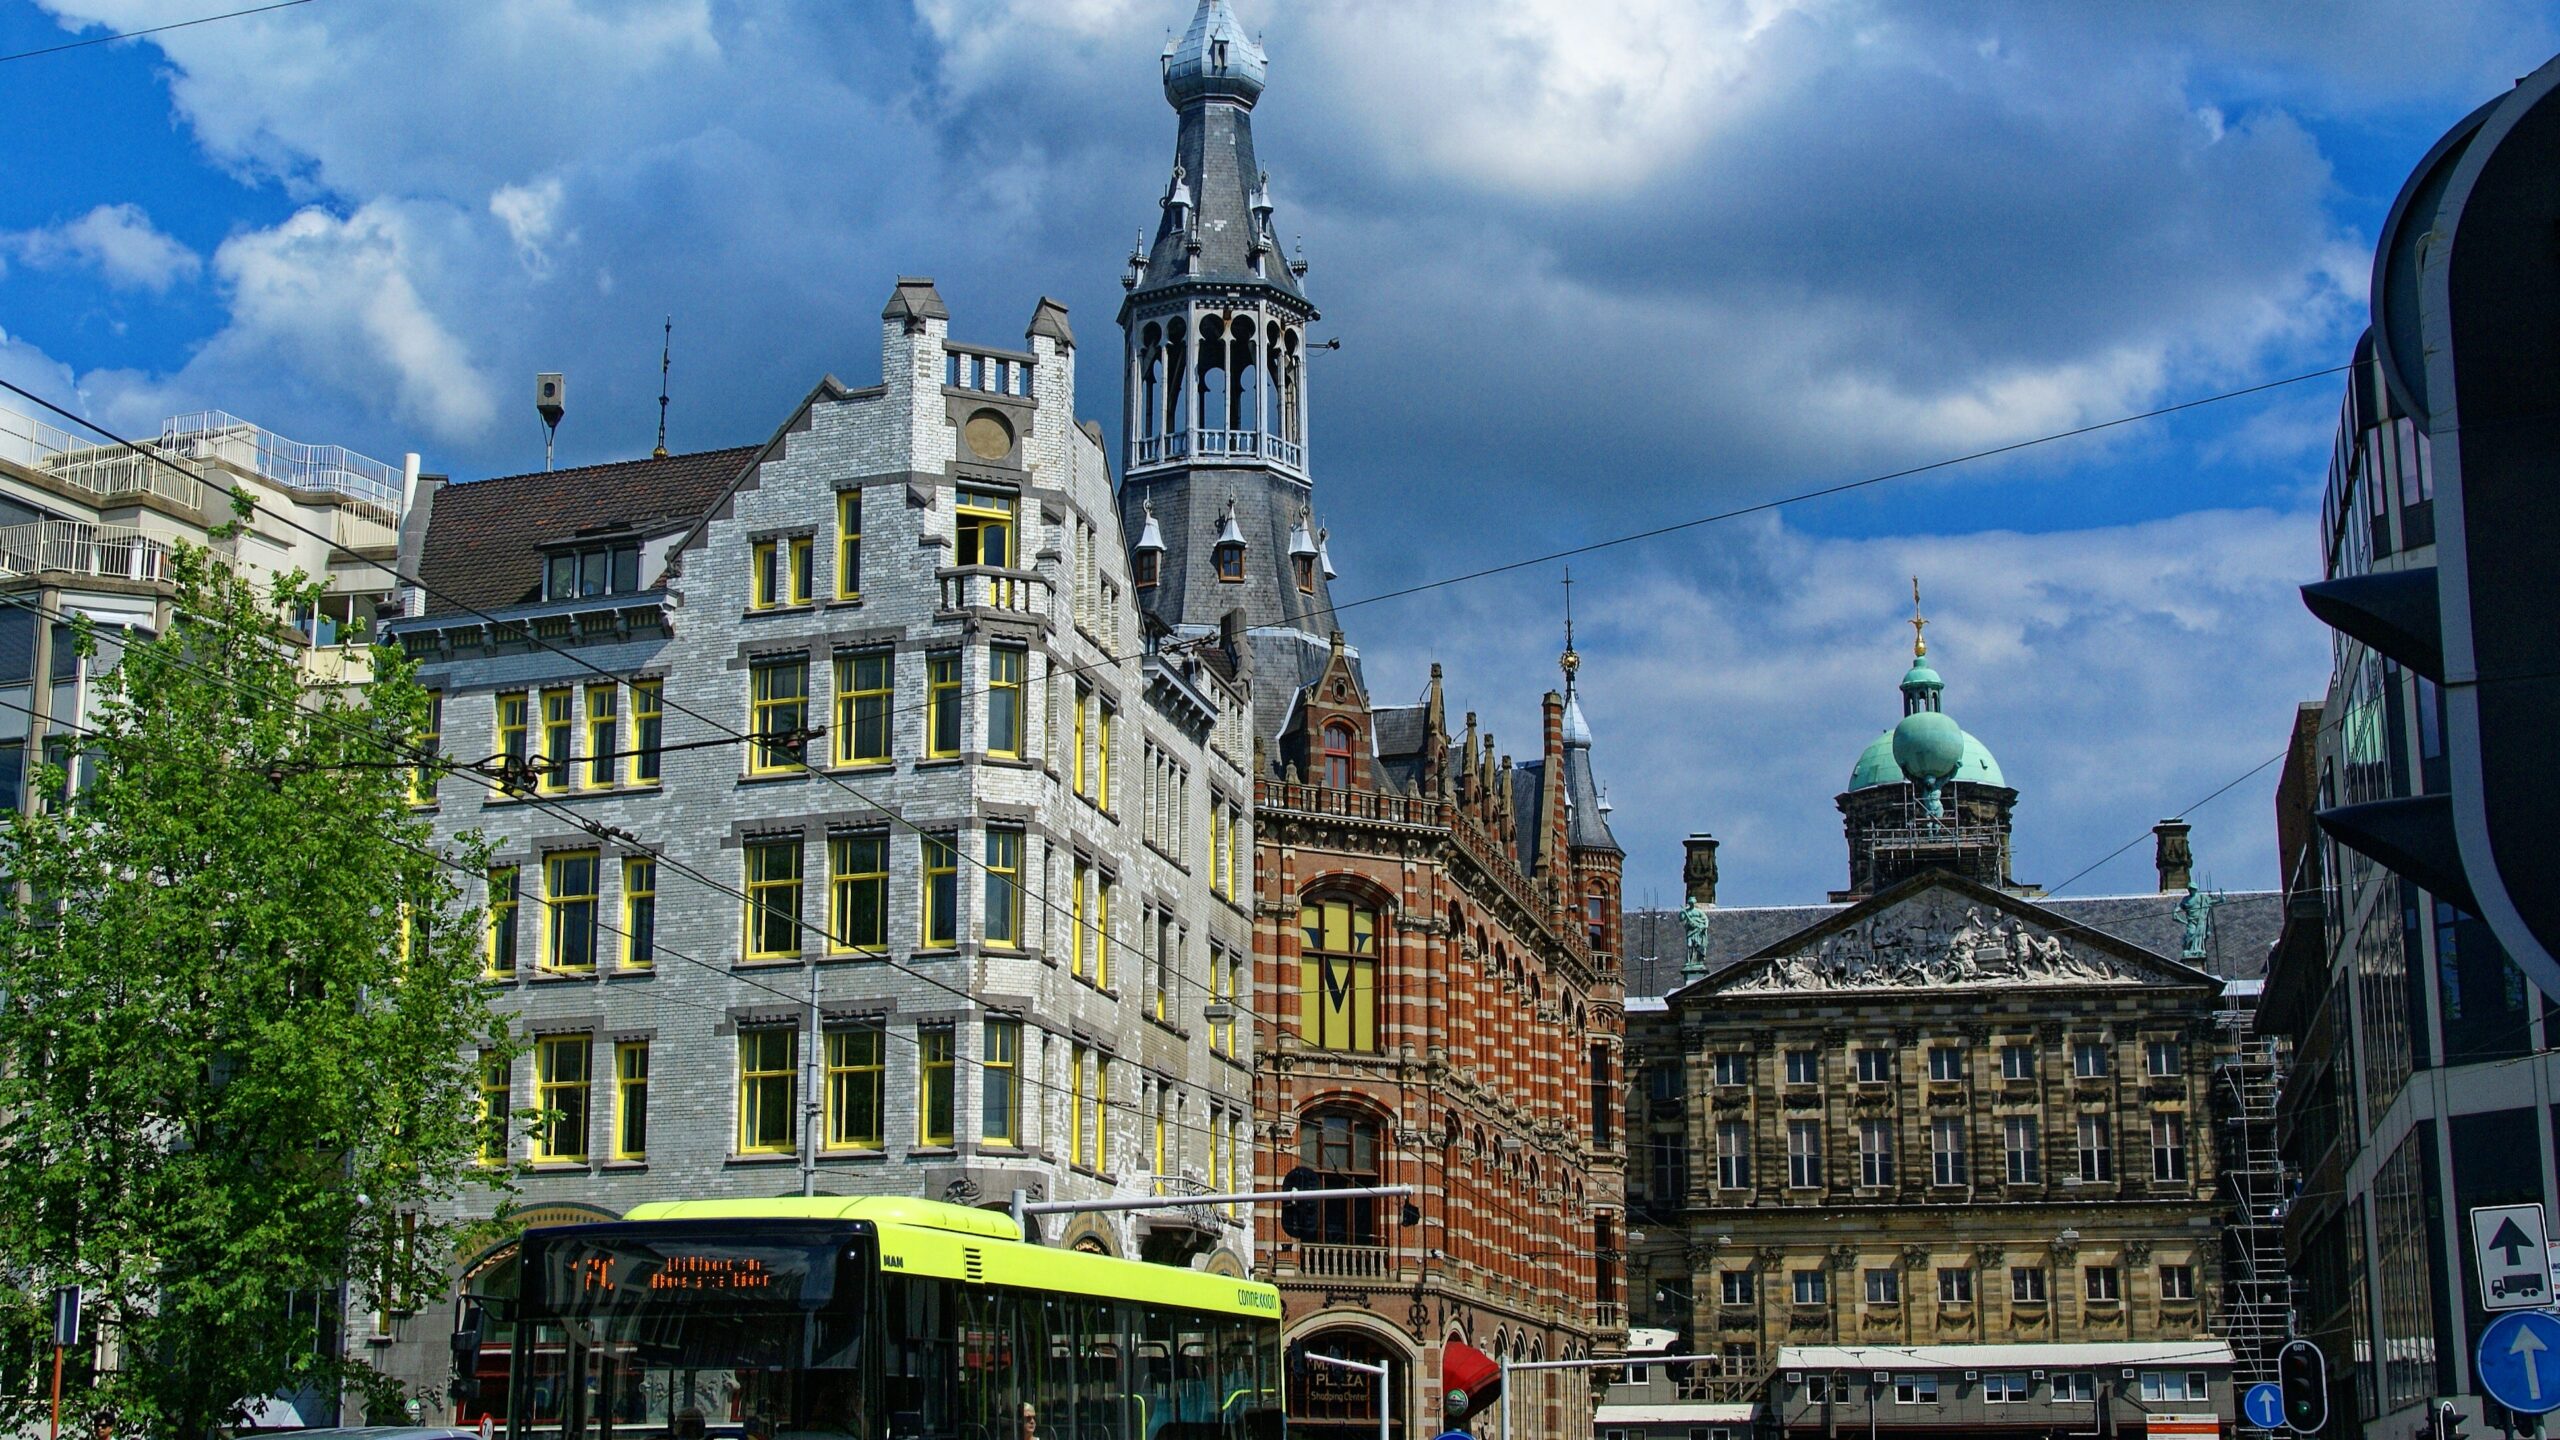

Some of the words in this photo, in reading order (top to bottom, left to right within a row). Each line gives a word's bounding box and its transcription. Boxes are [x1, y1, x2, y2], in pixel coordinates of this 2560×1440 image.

[883, 1254, 904, 1268] MAN
[1315, 1372, 1364, 1387] PLZA
[1311, 1390, 1343, 1402] Shopping
